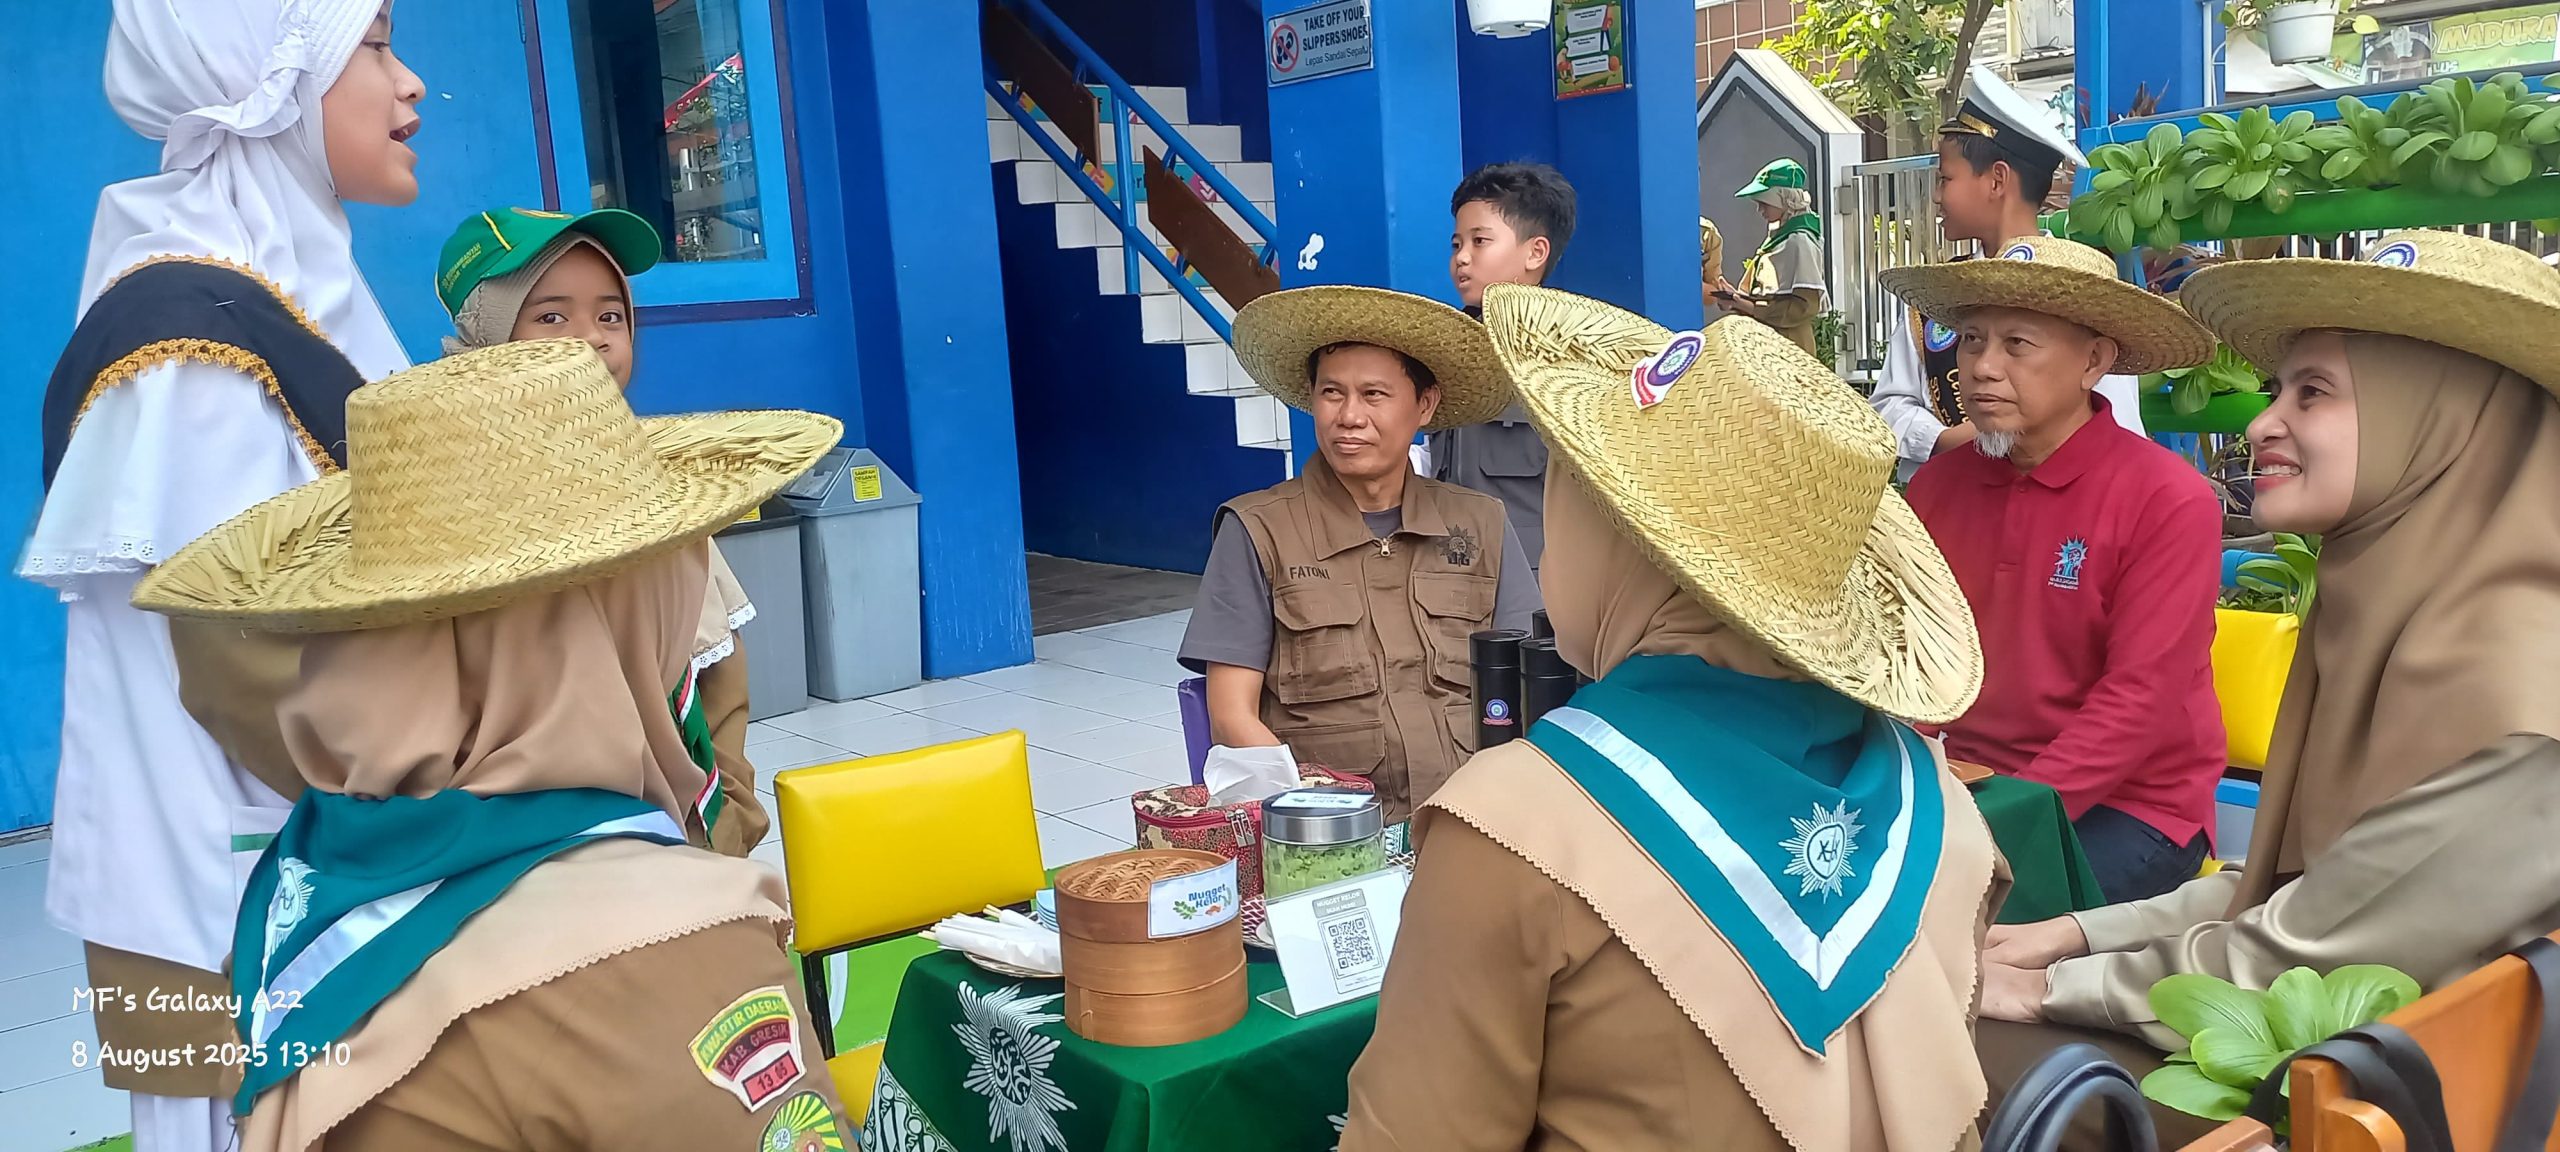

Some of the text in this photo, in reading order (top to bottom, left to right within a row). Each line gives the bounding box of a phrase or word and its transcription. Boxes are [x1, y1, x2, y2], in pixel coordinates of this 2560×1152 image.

[1304, 6, 1365, 31] TAKE OFF YOUR
[2438, 14, 2558, 54] MADURA
[1289, 566, 1330, 580] FATONI
[1188, 883, 1226, 902] Nugget
[1195, 894, 1222, 908] Kelor
[700, 1011, 745, 1064] KWARTIR
[750, 1023, 788, 1048] GRESIK
[757, 1073, 774, 1091] 13
